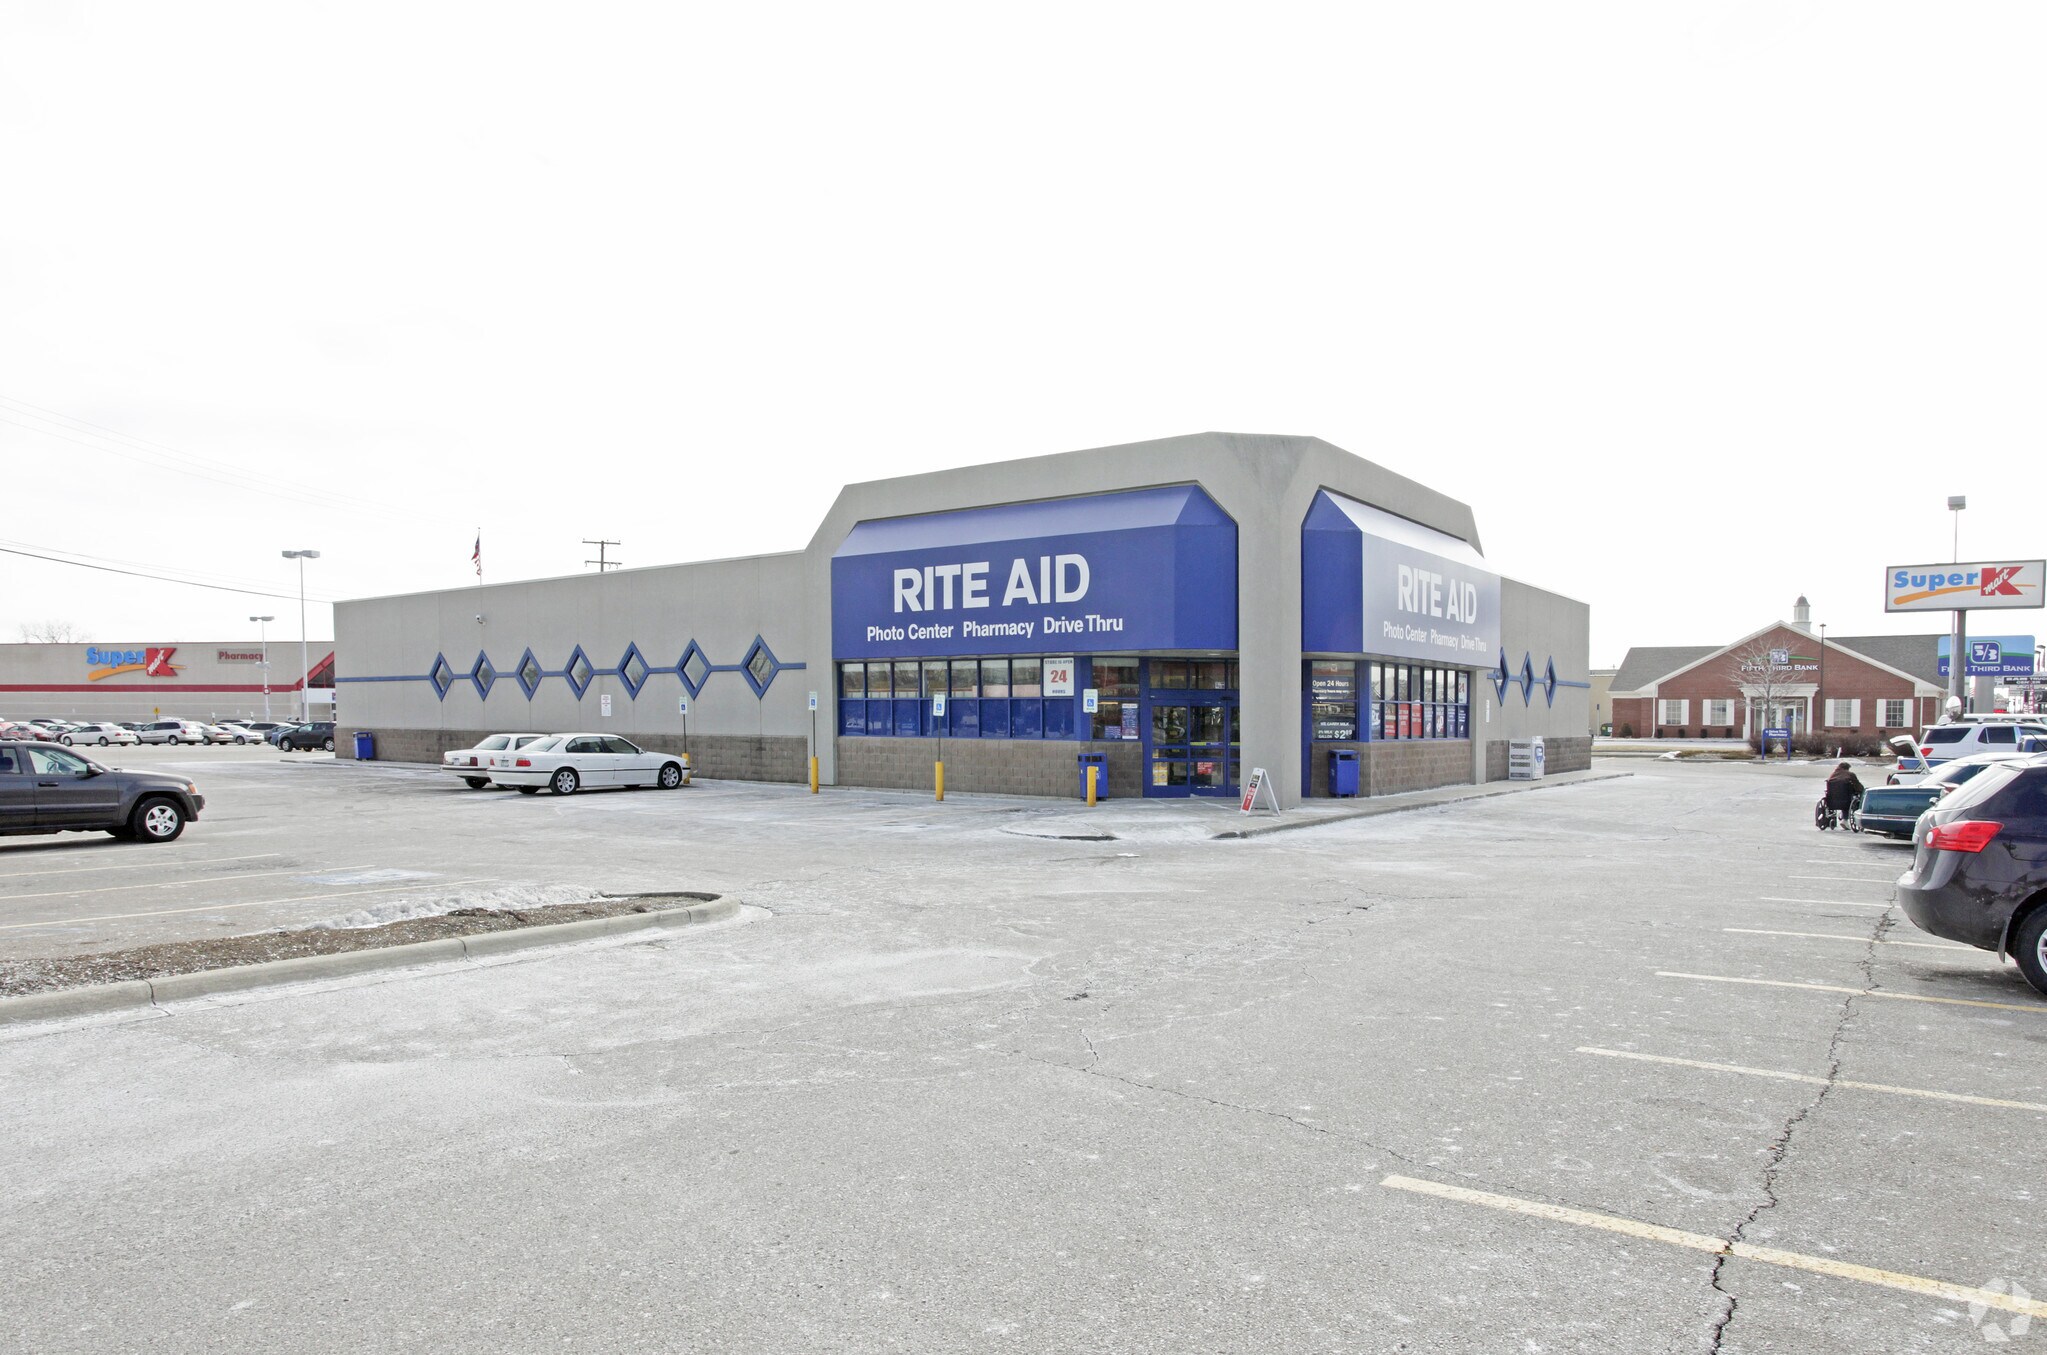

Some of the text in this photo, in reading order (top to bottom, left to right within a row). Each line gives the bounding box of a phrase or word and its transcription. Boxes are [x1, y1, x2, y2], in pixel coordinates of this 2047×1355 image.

[893, 553, 1091, 613] RITE AID
[1894, 570, 1979, 592] Super
[1398, 563, 1478, 625] RITE AID
[867, 614, 1123, 642] Photo Center Pharmacy Drive Thru
[1383, 620, 1487, 652] Photo Center Pharmacy Drive Thru
[86, 646, 146, 668] Super
[218, 651, 264, 662] Pharmacy
[1050, 669, 1067, 683] 24
[1312, 680, 1326, 688] Open
